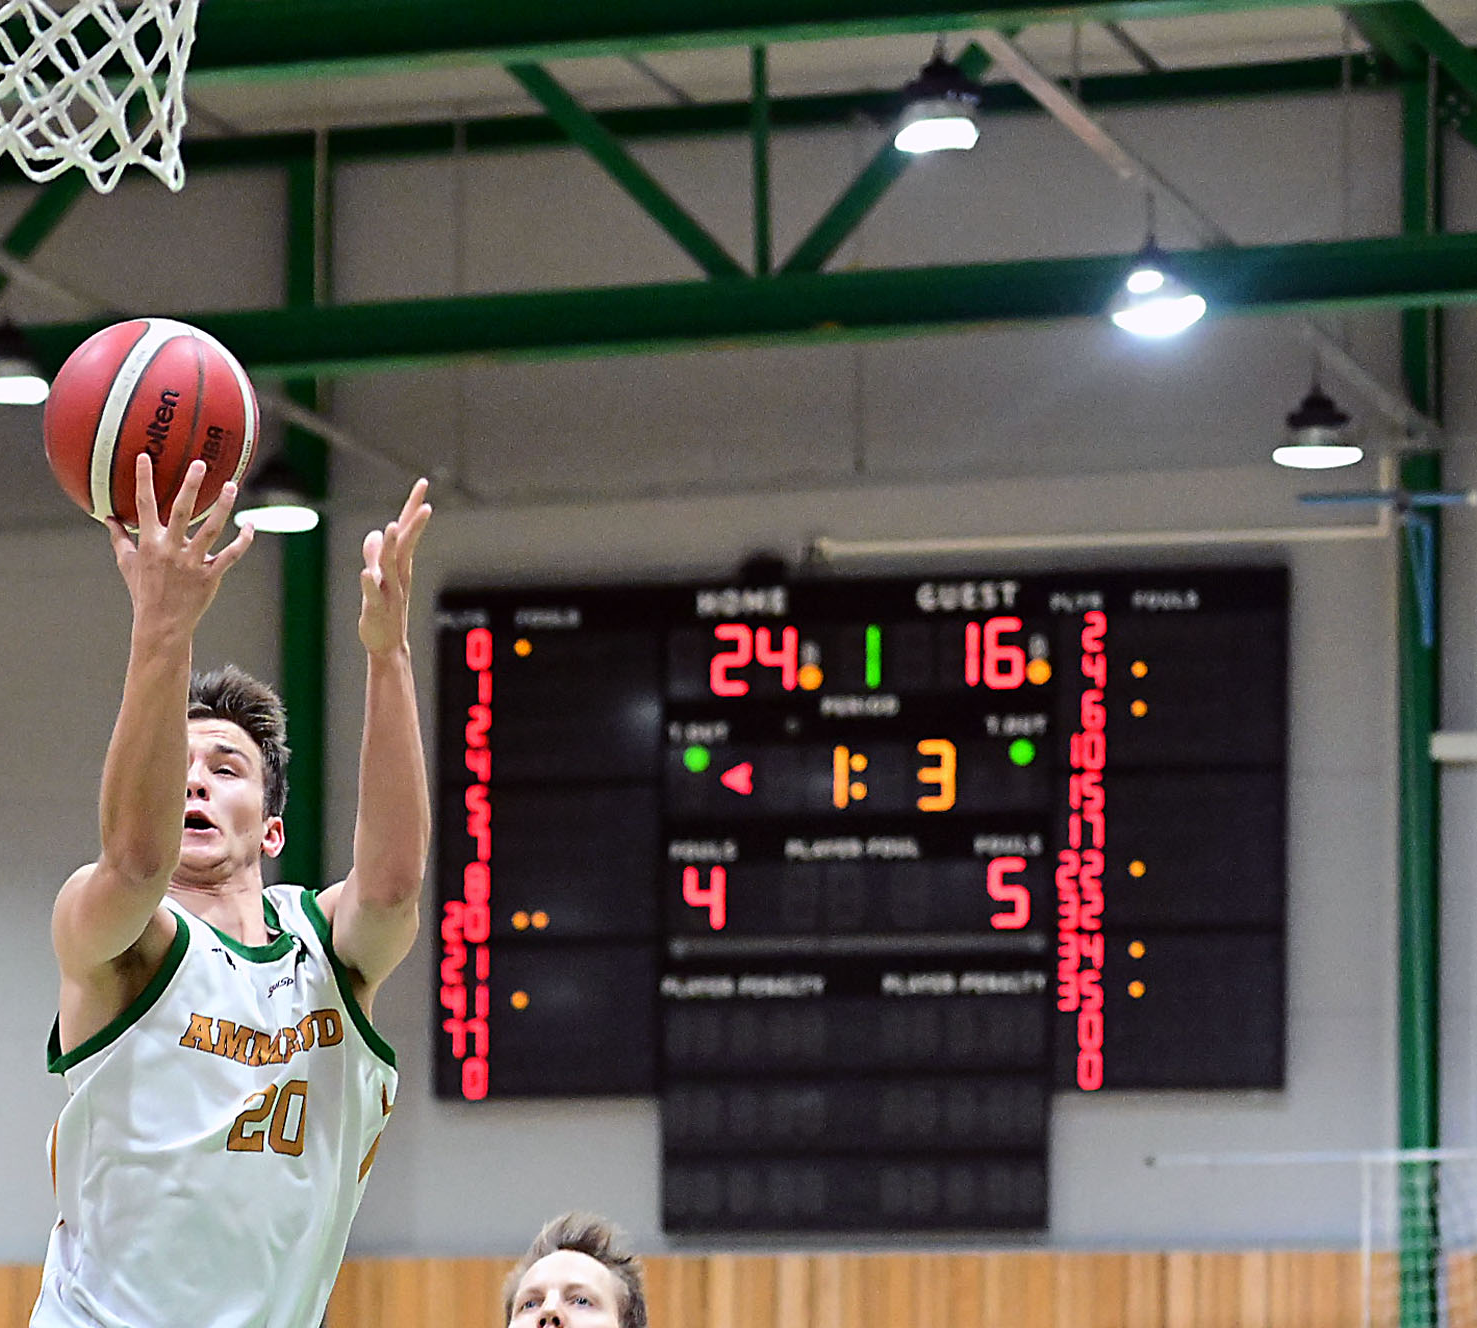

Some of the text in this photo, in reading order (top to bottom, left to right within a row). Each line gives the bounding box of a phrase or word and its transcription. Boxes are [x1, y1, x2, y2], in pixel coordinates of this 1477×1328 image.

[139, 388, 180, 472] olten
[710, 623, 799, 696] 24
[865, 623, 882, 689] 1
[965, 616, 1026, 690] 16
[682, 865, 727, 931] 4
[986, 856, 1031, 930] 5
[226, 1079, 308, 1157] 20
